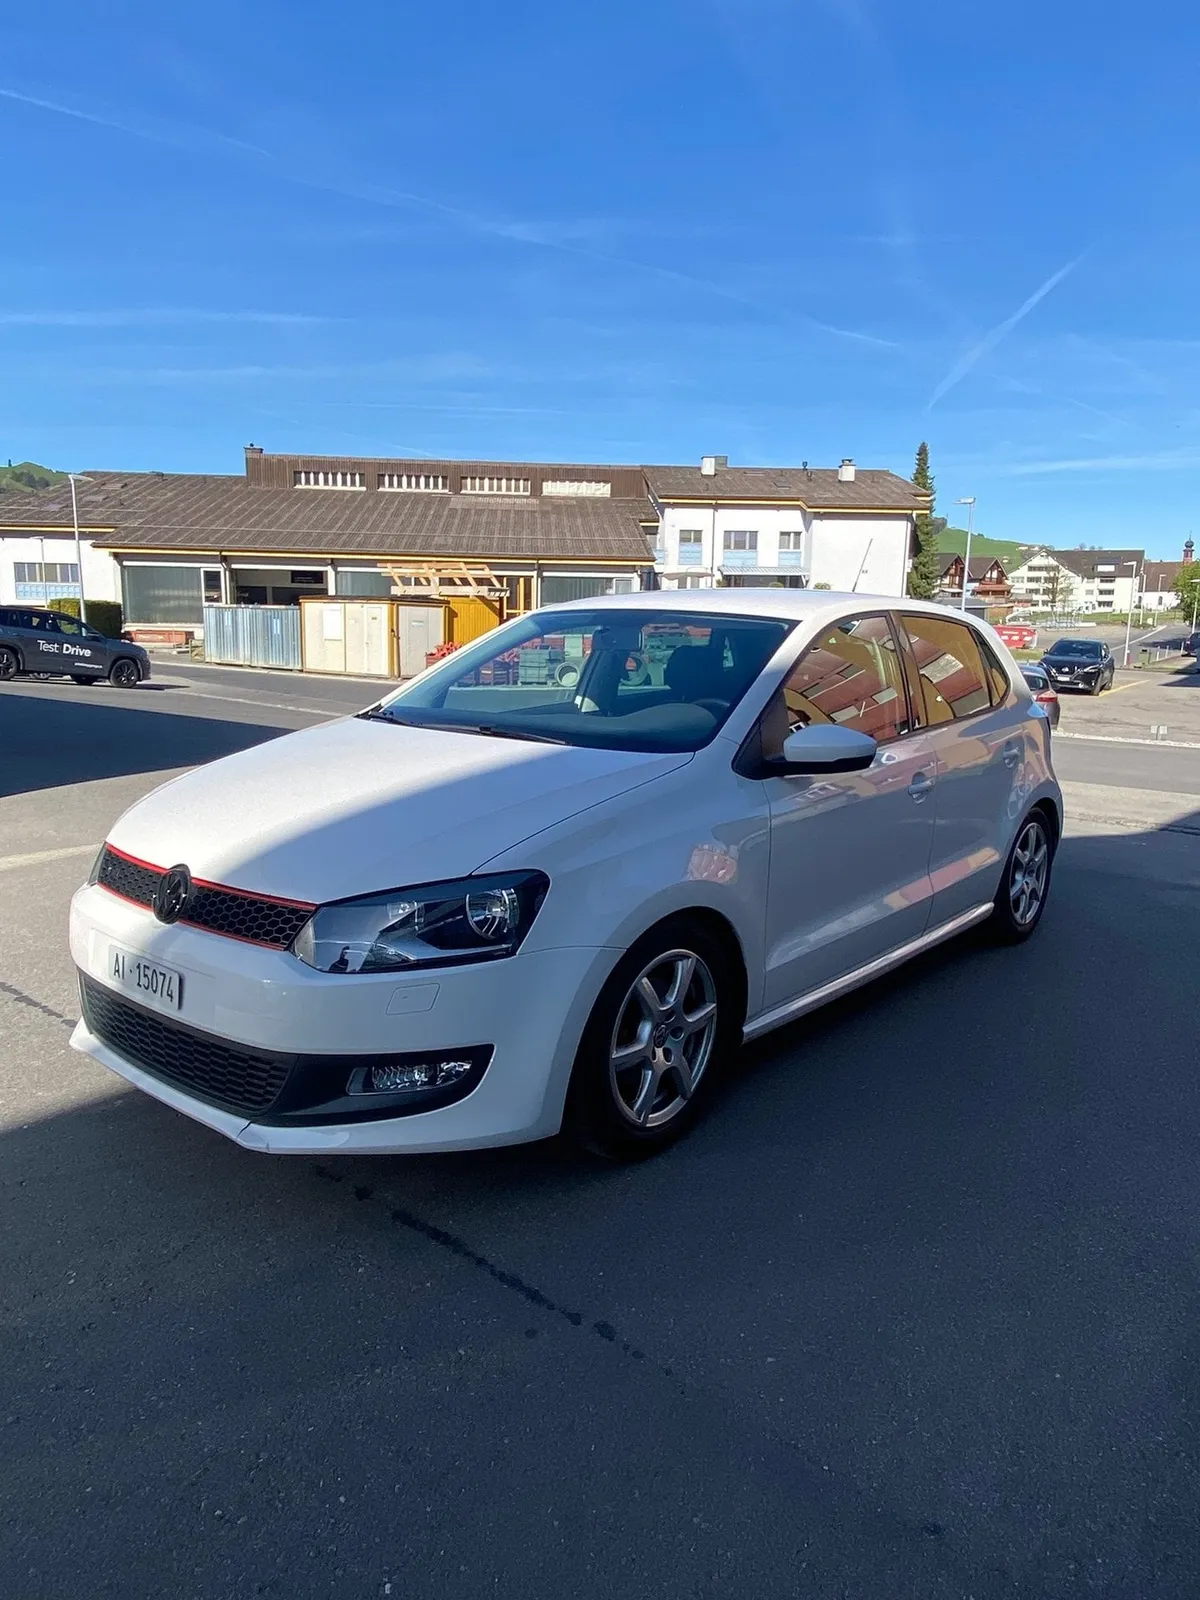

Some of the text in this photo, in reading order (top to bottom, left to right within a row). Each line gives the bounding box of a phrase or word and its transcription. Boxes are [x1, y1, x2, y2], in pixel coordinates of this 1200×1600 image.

[37, 640, 92, 657] Test Drive
[113, 952, 125, 980] AI
[136, 962, 174, 1003] 15074
